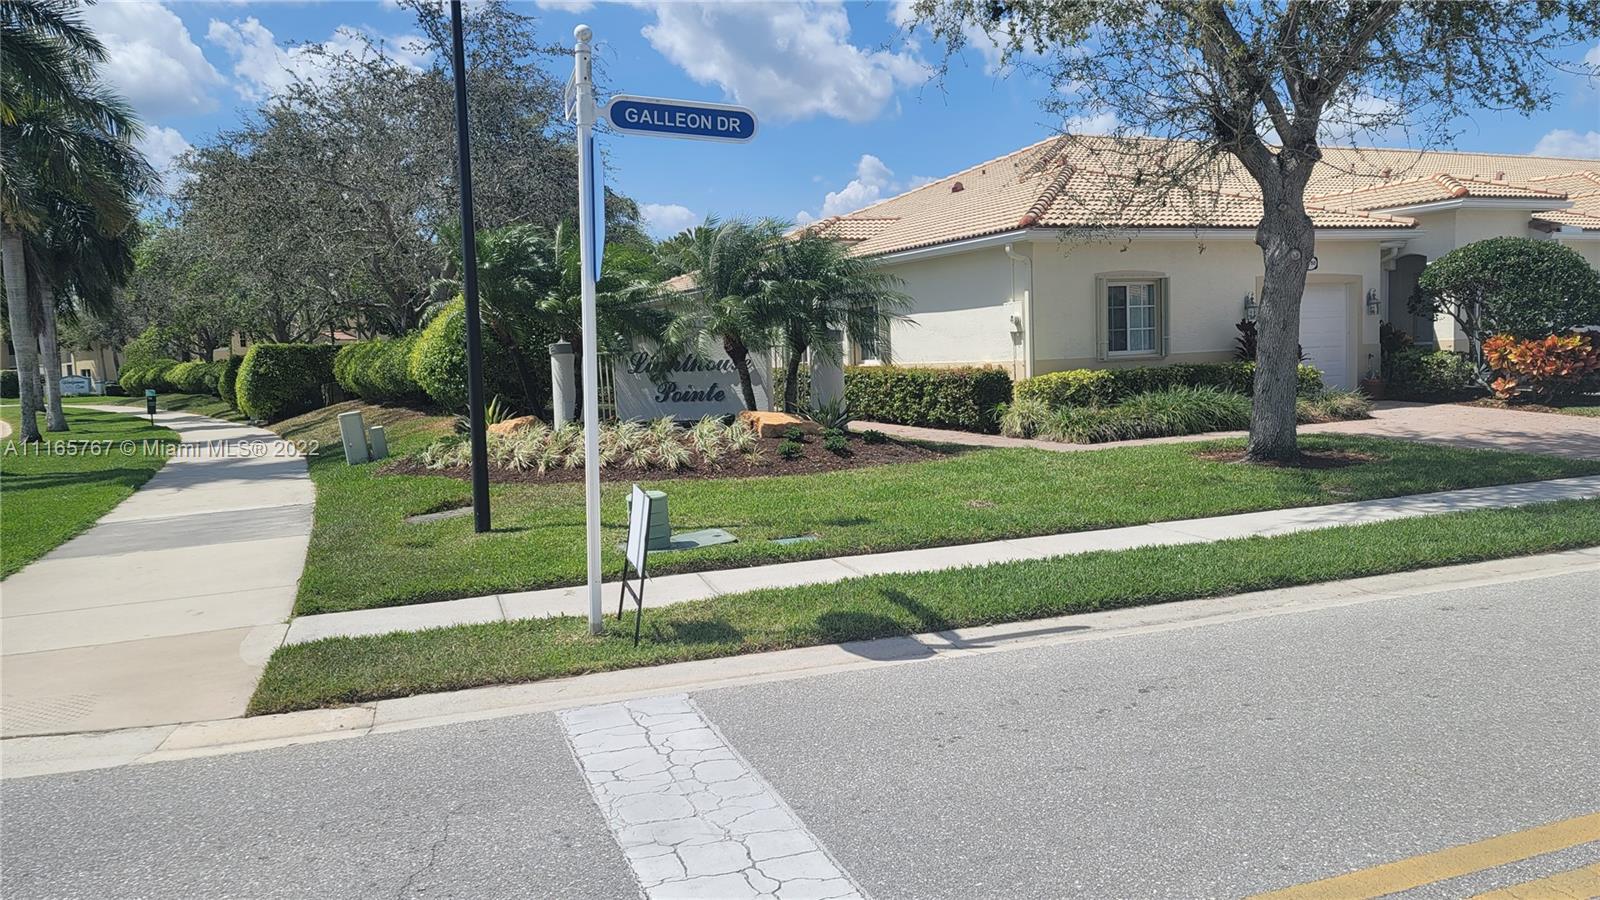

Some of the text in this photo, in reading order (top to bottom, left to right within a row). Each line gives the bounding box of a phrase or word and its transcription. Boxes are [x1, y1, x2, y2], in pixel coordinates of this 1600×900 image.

[625, 107, 741, 133] GALLEON DR
[654, 381, 726, 403] Pointe
